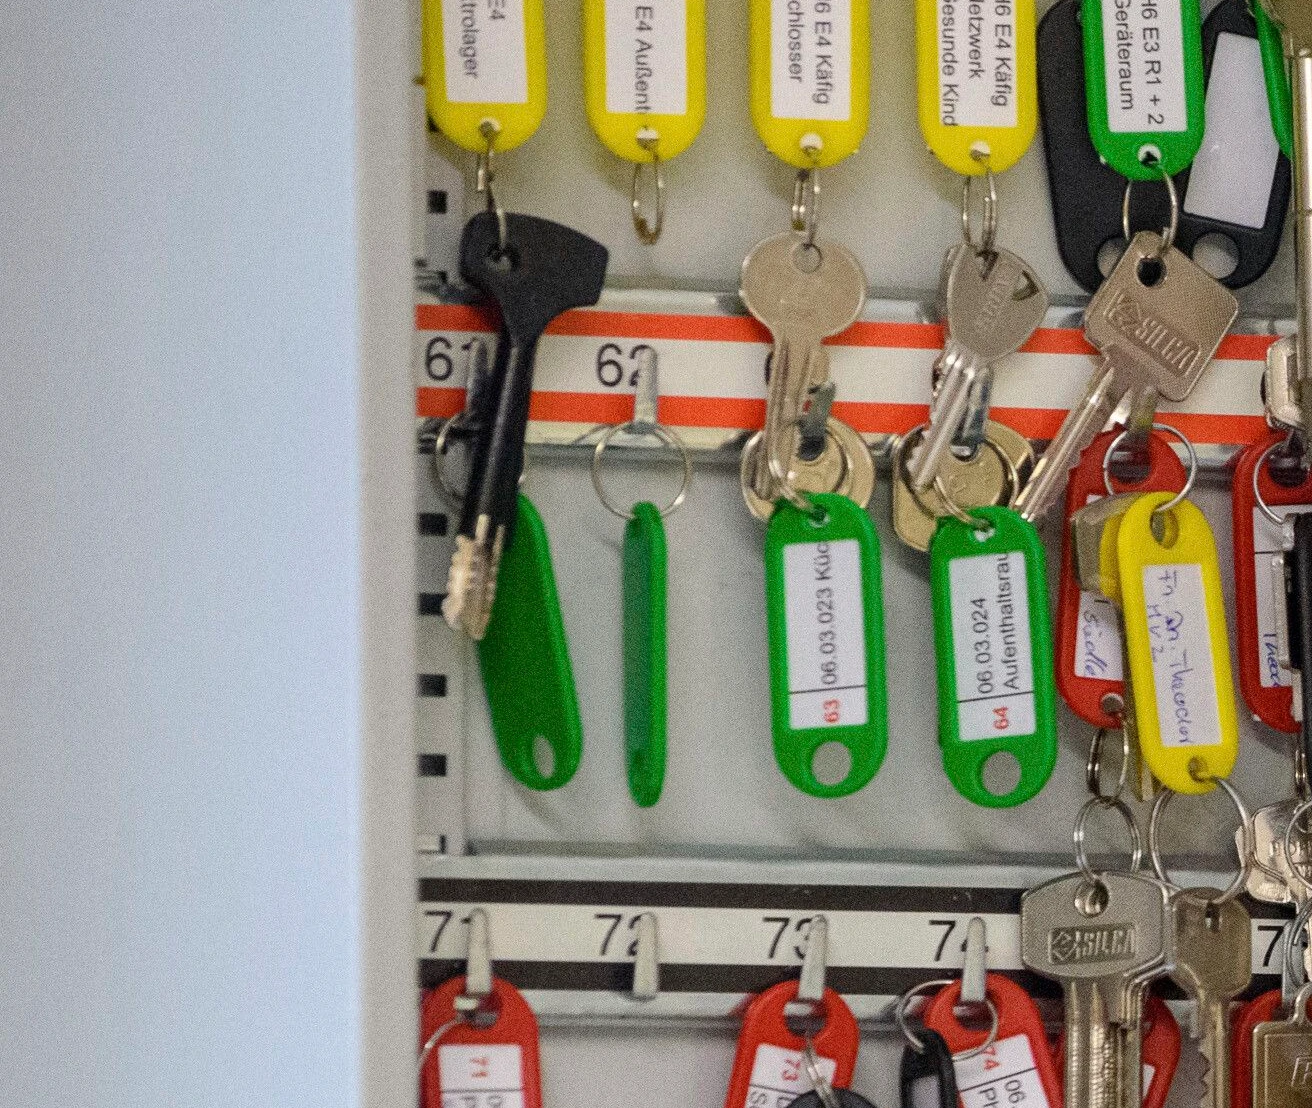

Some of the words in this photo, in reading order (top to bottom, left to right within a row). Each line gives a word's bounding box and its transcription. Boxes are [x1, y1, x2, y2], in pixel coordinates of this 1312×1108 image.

[636, 4, 654, 30] E4
[815, 20, 831, 48] E4
[994, 23, 1012, 50] E4
[1142, 27, 1160, 54] E3
[812, 54, 833, 105] Käfig
[991, 56, 1013, 108] Käfig
[1143, 60, 1160, 87] R1
[942, 84, 959, 127] Kind
[1147, 113, 1164, 125] 2
[817, 587, 838, 684] 06.03.023
[970, 598, 993, 694] 06.03.024
[823, 698, 840, 722] 63
[992, 706, 1009, 730] 64
